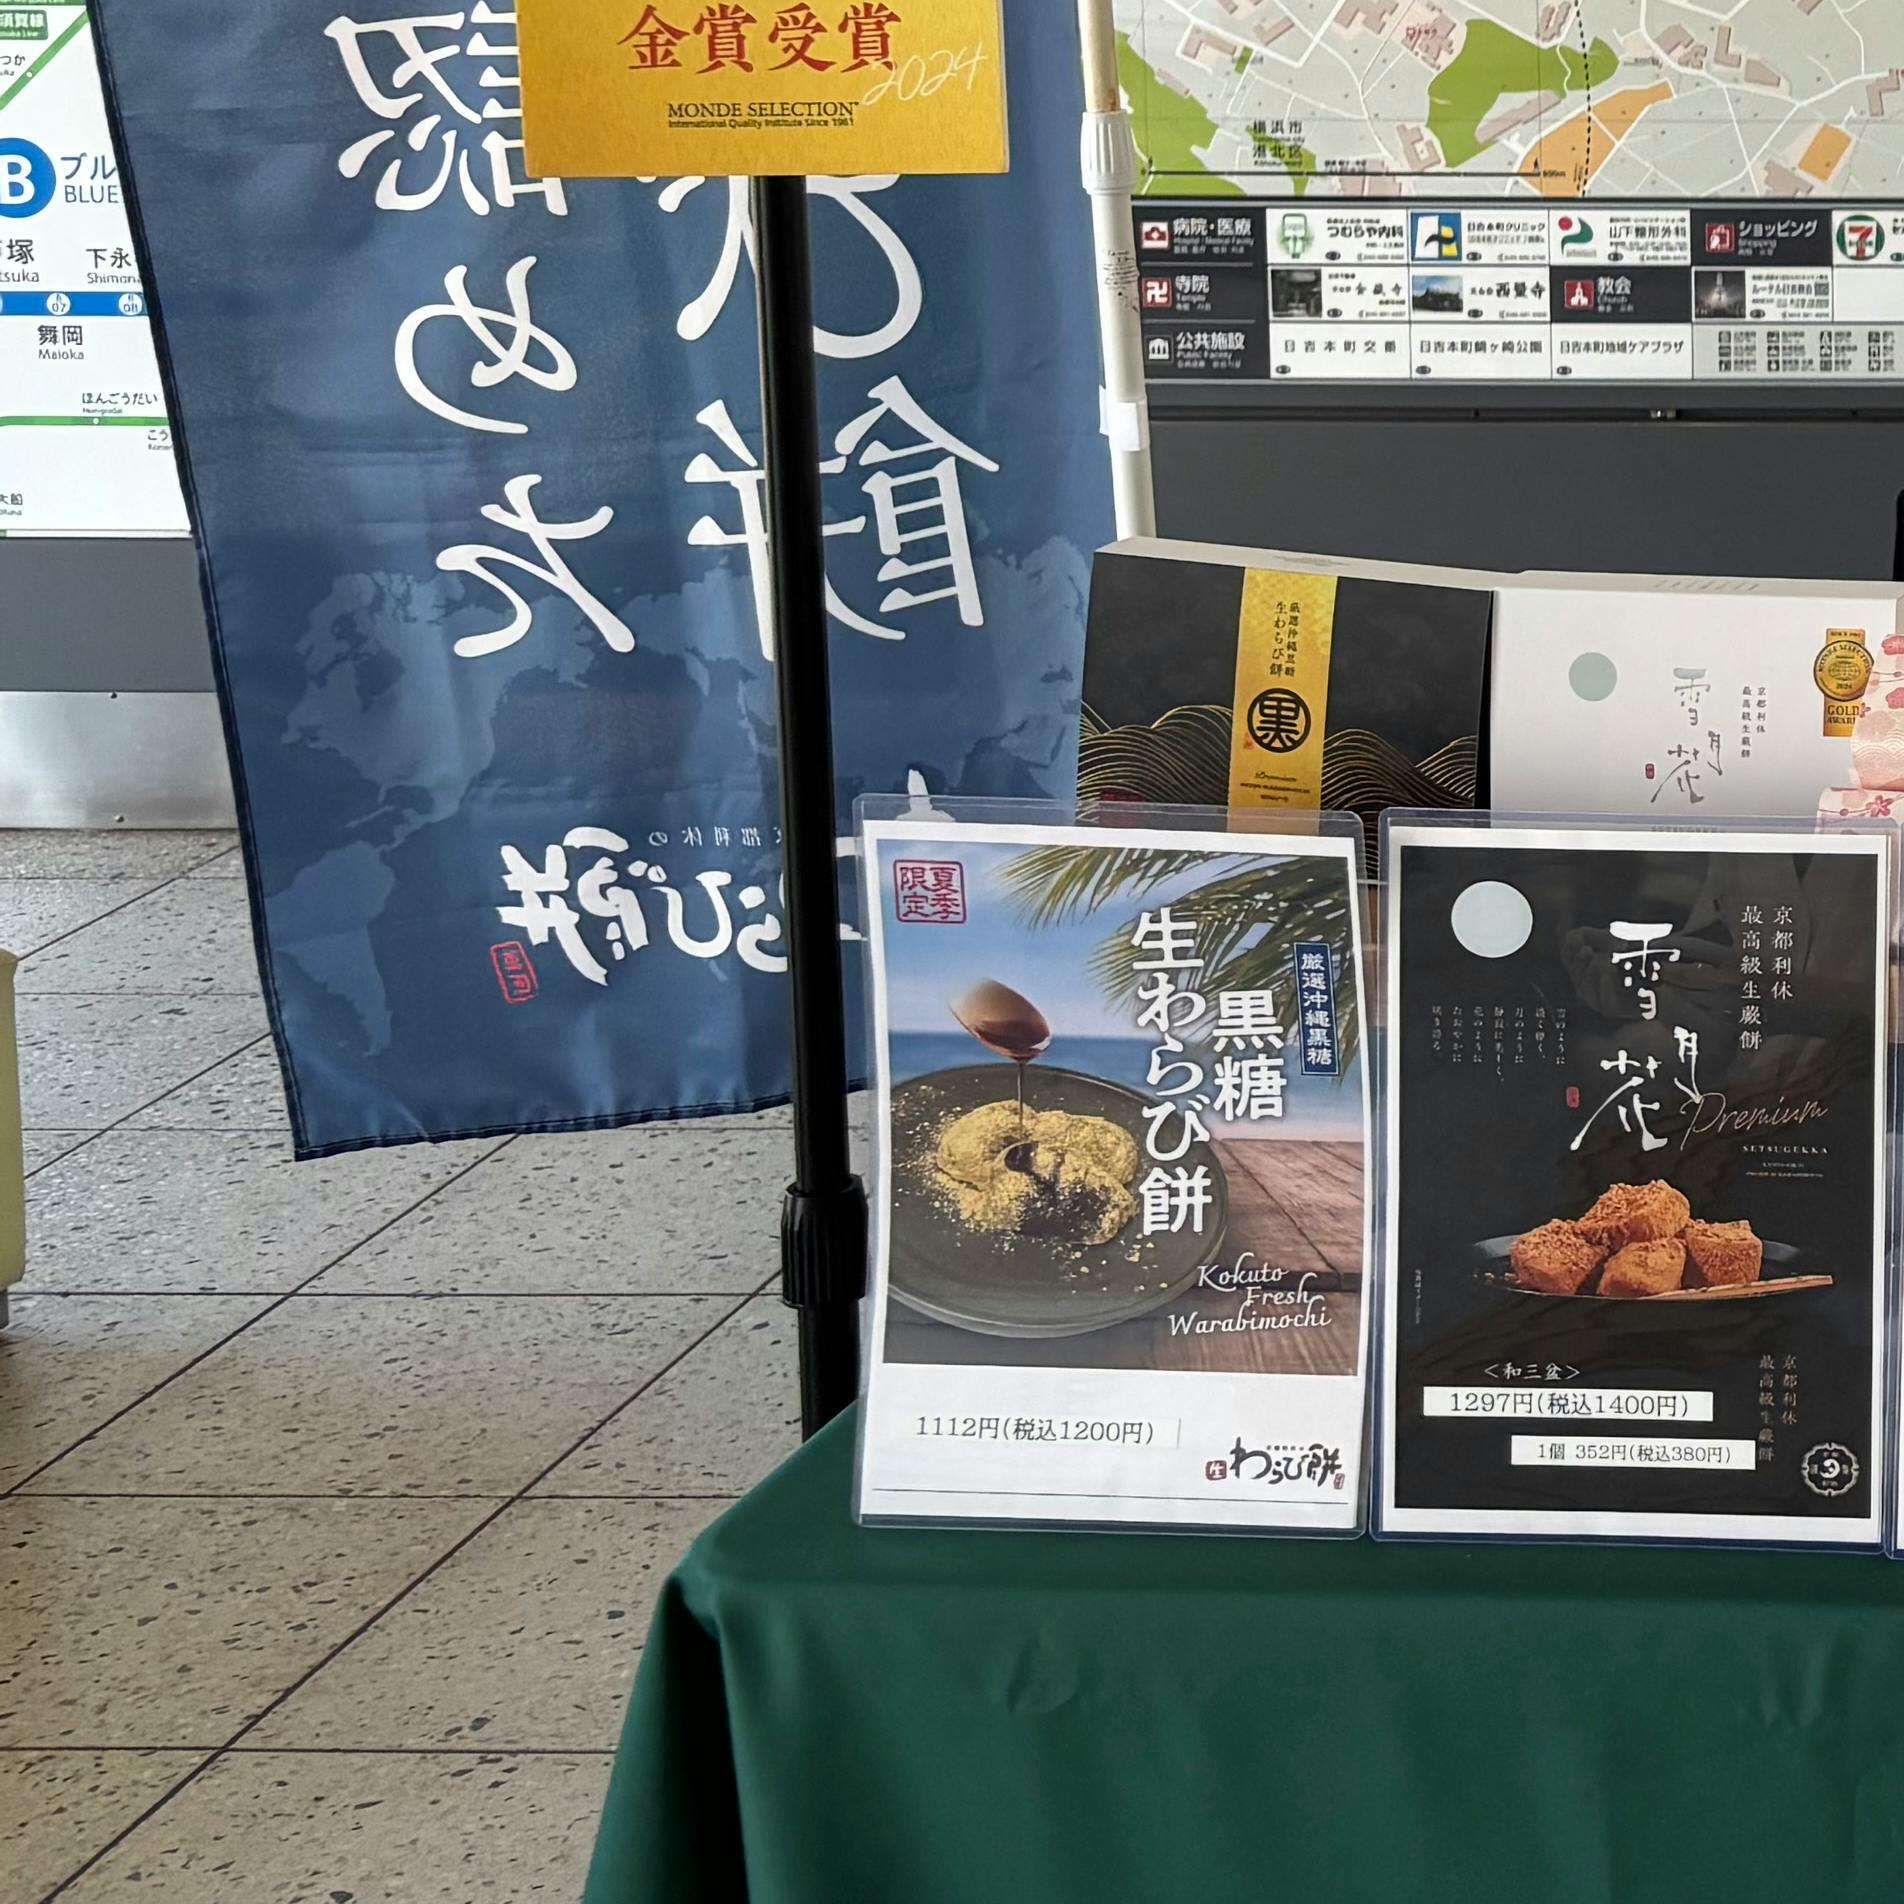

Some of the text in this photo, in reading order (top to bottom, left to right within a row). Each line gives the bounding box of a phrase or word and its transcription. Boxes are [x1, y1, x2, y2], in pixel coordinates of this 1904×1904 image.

[616, 3, 902, 74] 金賞受賞
[862, 42, 987, 107] 2024
[667, 100, 854, 118] MONDE SELECTION
[668, 118, 763, 130] International Quality
[1253, 121, 1303, 133] 横浜市
[1253, 145, 1302, 158] 港北区
[65, 186, 119, 203] BLUE
[1173, 218, 1252, 236] 病院・医療
[1327, 225, 1404, 238] つむらや内科
[1738, 220, 1817, 237] ショッピング
[1175, 275, 1210, 294] 寺院
[1597, 277, 1631, 295] 教会
[37, 325, 83, 346] 舞岡
[1176, 333, 1246, 351] 公共施設
[38, 349, 84, 360] Maioka
[82, 392, 158, 406] ほんごうだい
[1270, 602, 1287, 677] 生わらび餅
[1256, 696, 1300, 748] 黒
[1827, 705, 1859, 716] GOLD
[1771, 904, 1794, 1000] 京都利休
[1739, 904, 1764, 1050] 最高級生蕨餅
[1300, 953, 1334, 1068] 厳選沖縄黒糖
[1212, 990, 1287, 1123] 黒糖
[1130, 908, 1213, 1237] 生わらび餅
[1680, 1092, 1832, 1153] Premium
[1742, 1144, 1830, 1156] SETSUGEKKA
[1197, 1263, 1289, 1292] Kokuto
[1246, 1271, 1319, 1308] Fresh
[1168, 1298, 1333, 1338] Warabimochi
[1450, 1391, 1689, 1418] 1297円(税込1400円)
[916, 1414, 1155, 1446] 1112円(税込1200円)
[1230, 1437, 1342, 1487] わらび餅
[1537, 1442, 1732, 1465] 1個 352円(税込380円)
